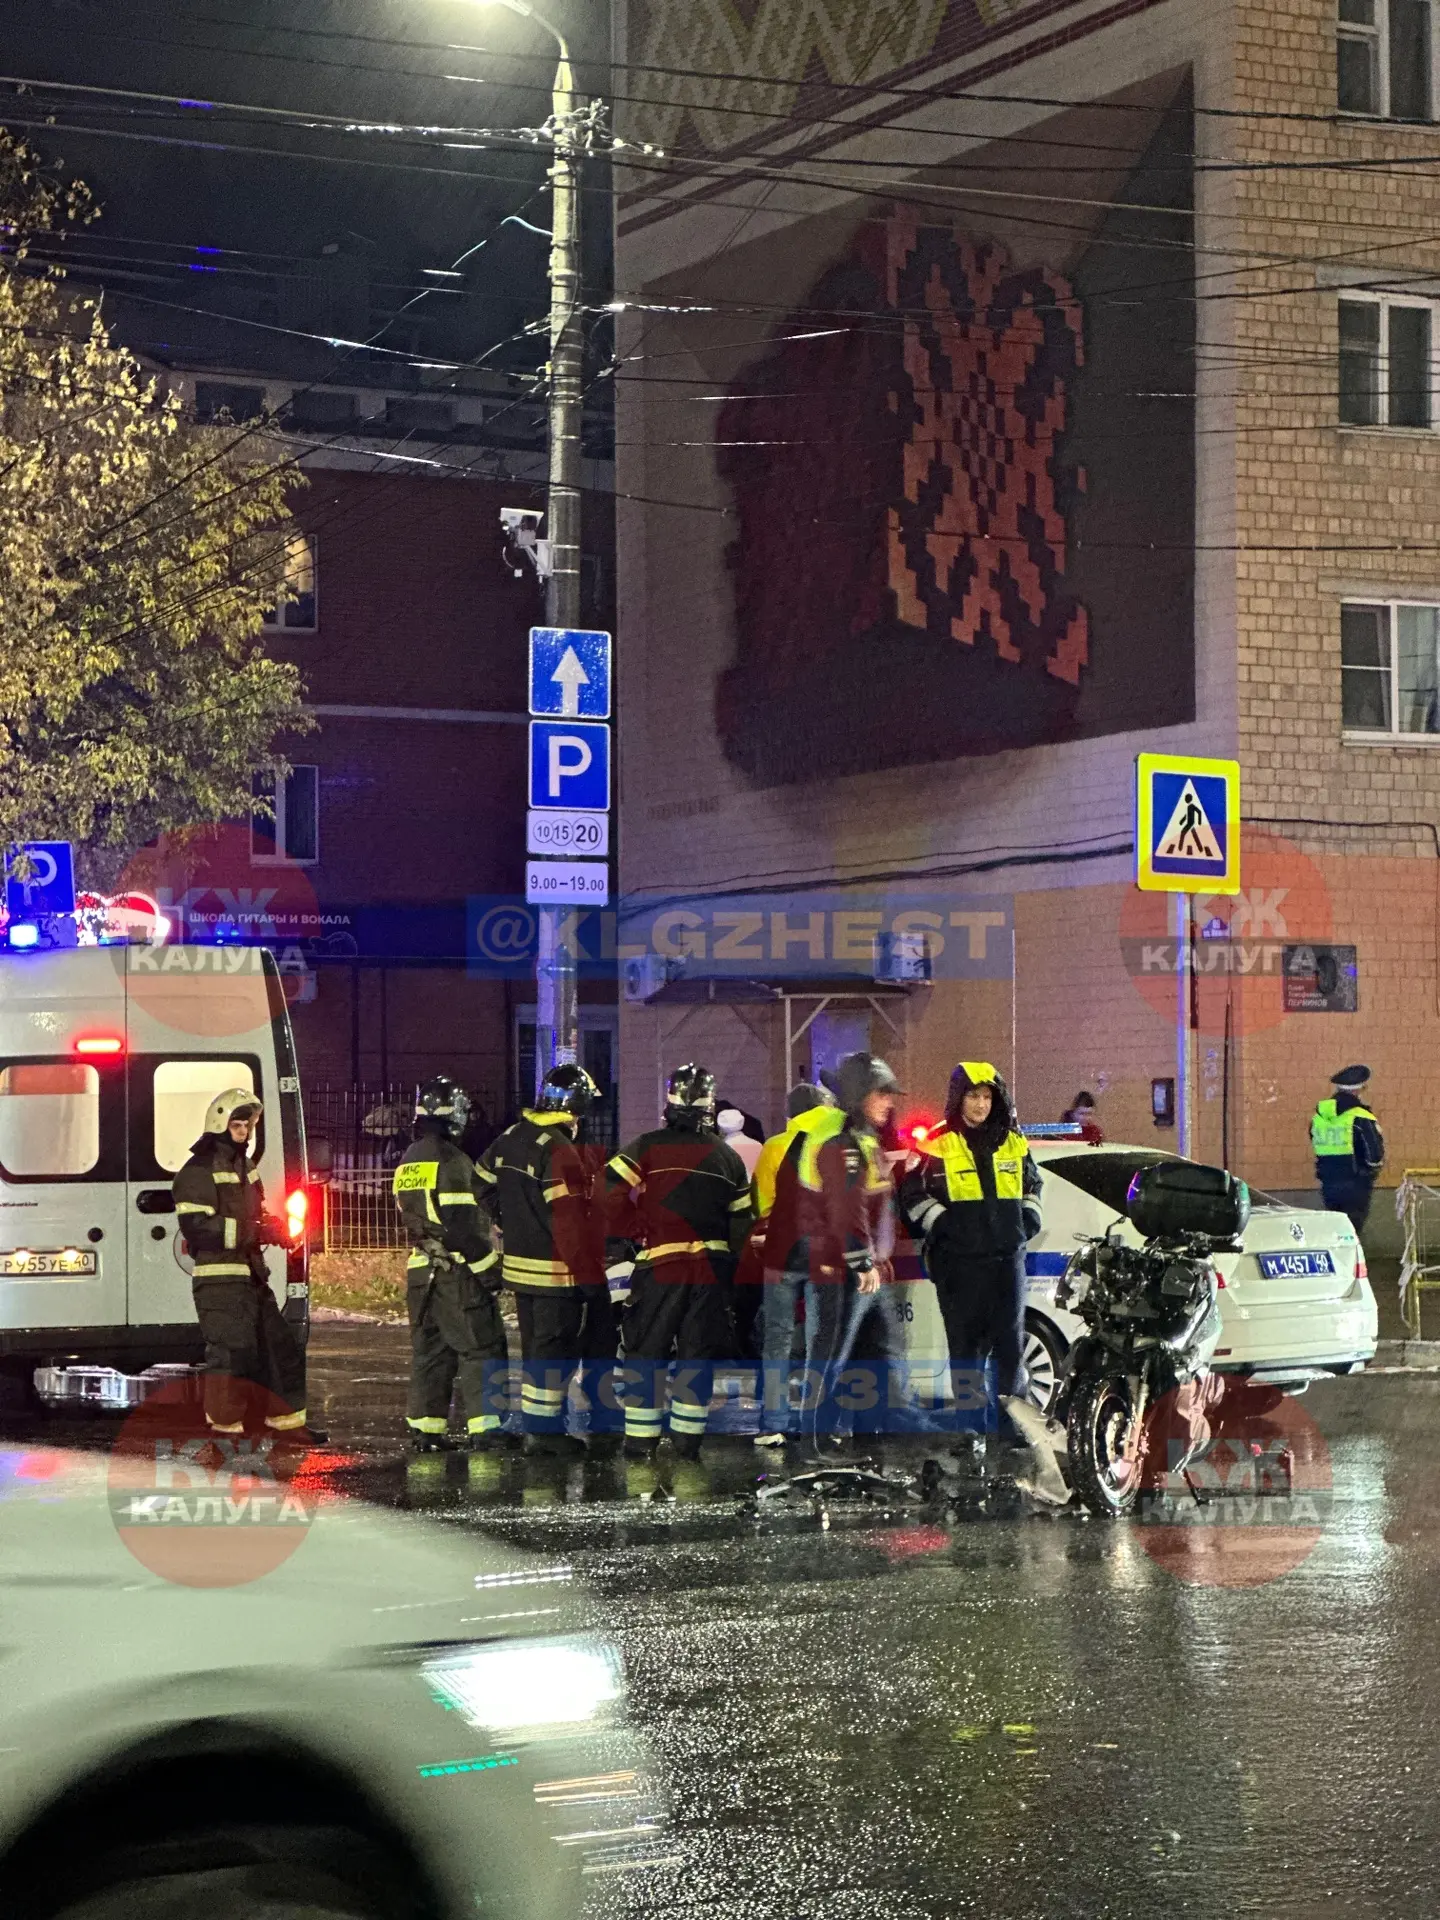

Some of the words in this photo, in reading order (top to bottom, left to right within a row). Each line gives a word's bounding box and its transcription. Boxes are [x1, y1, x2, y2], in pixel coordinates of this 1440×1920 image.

[549, 736, 592, 797] P
[537, 826, 549, 838] 10
[554, 825, 569, 839] 15
[576, 825, 598, 843] 20
[24, 851, 58, 907] P
[189, 913, 234, 923] ШКОЛА
[238, 913, 286, 924] ГИТАРЫ
[289, 915, 298, 924] И
[301, 915, 351, 925] ВОКАЛА
